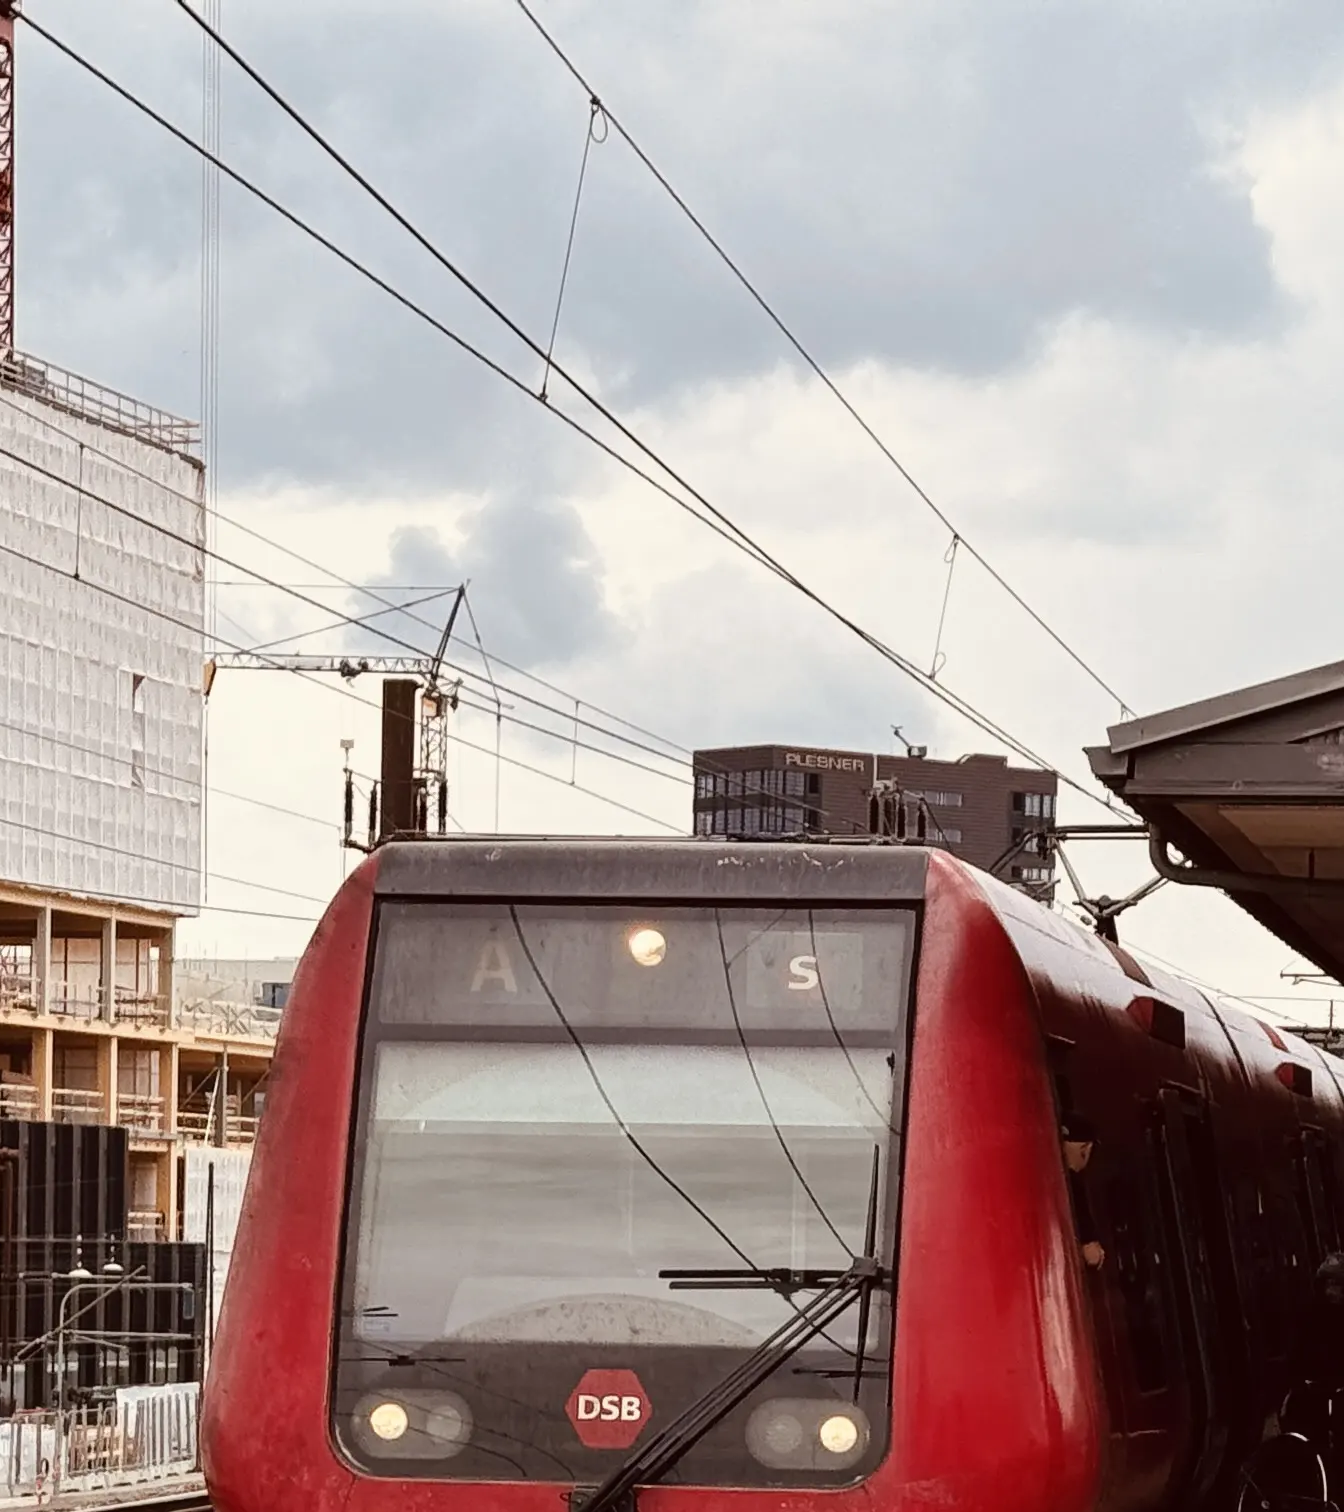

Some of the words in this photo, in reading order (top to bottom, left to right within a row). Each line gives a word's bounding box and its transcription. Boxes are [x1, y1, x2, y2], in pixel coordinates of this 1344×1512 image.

[785, 752, 865, 773] PLESNER
[469, 940, 518, 994] A
[577, 1394, 641, 1421] DSB
